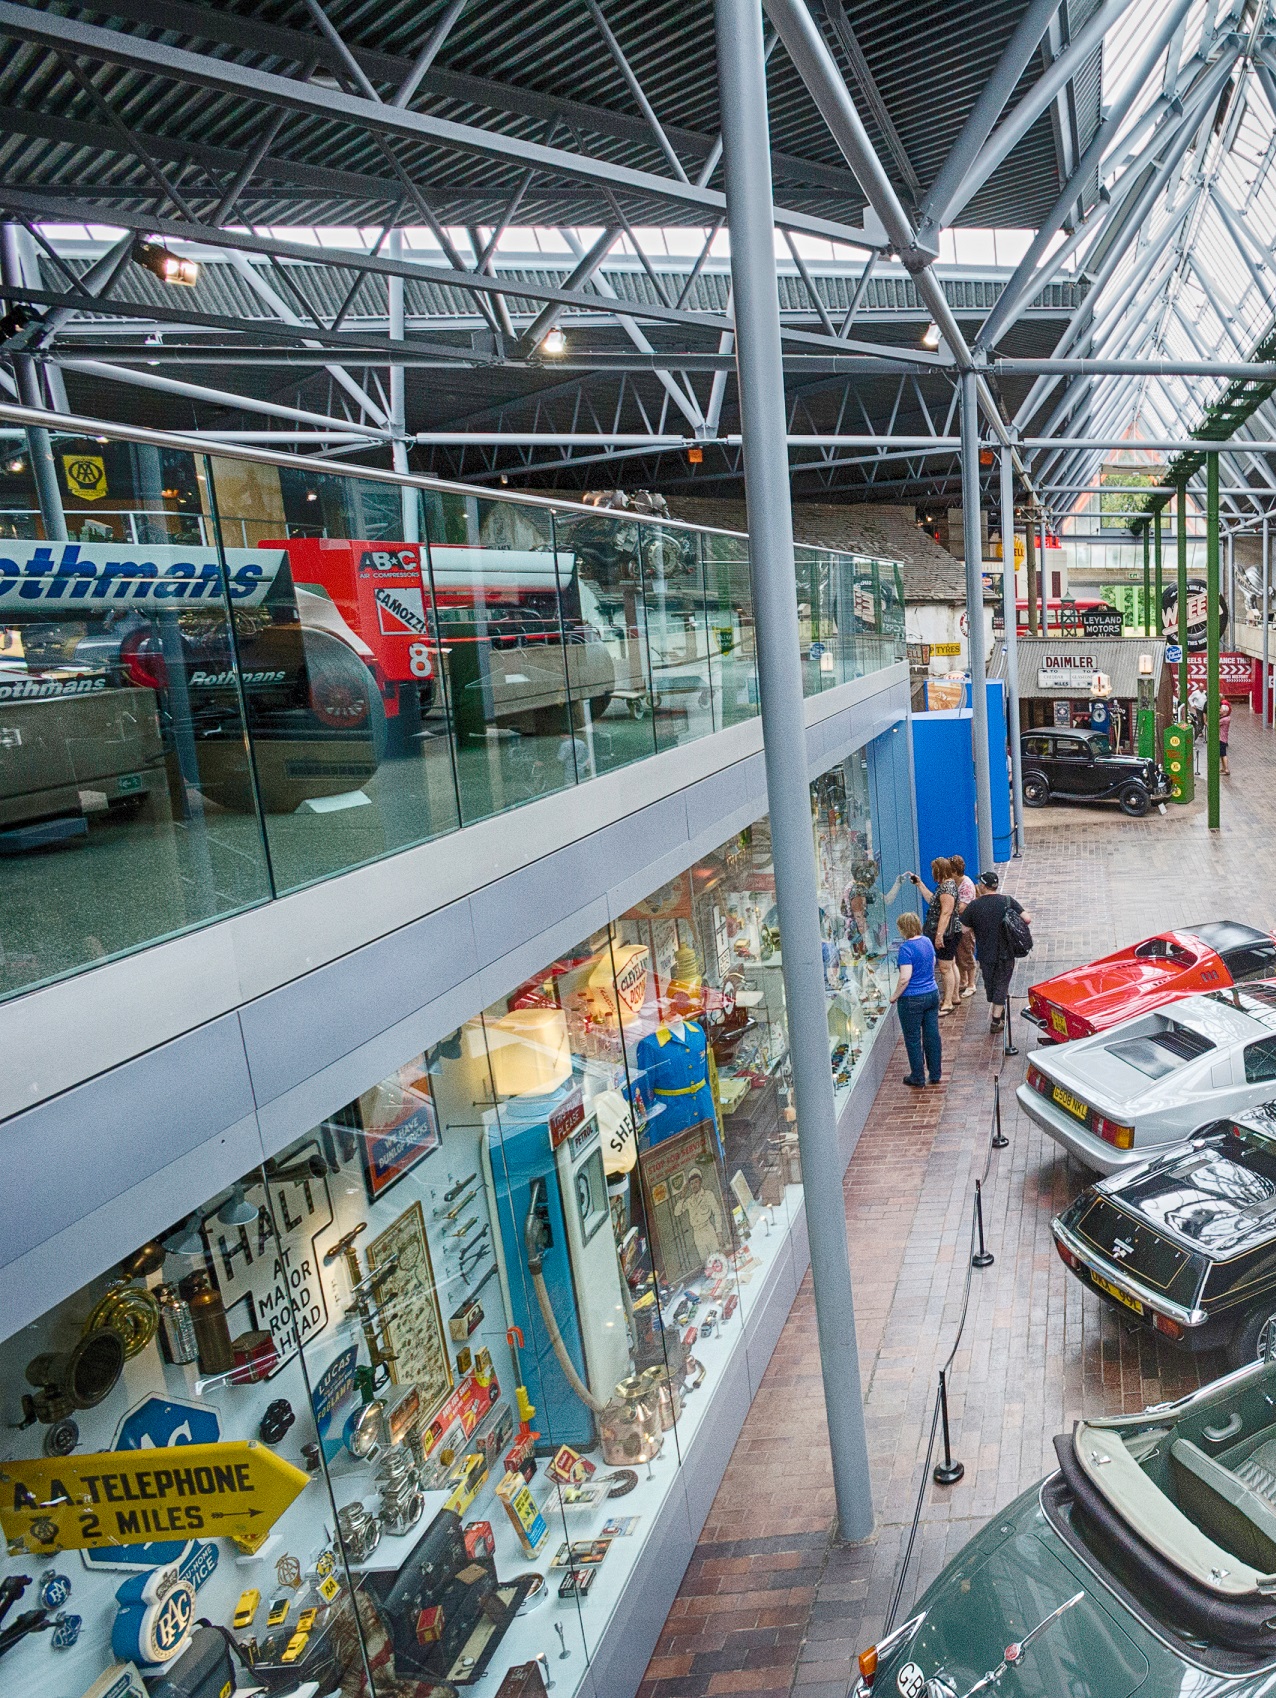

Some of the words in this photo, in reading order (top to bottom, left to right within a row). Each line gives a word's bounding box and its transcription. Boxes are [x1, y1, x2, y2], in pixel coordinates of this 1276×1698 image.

[1013, 547, 1024, 557] ELL
[0, 545, 263, 599] othmans
[376, 588, 427, 634] CAMOZZI
[1084, 616, 1122, 625] LEYLAND
[1086, 625, 1120, 633] MOTORS
[409, 643, 432, 678] 8
[936, 646, 960, 654] TYRES
[1046, 656, 1093, 668] DAIMLER
[0, 677, 105, 698] othmans
[1054, 1087, 1072, 1107] G508
[1071, 1098, 1088, 1119] NKL
[398, 1117, 418, 1136] HAVE
[558, 1109, 581, 1140] PLEASE
[574, 1123, 595, 1149] PETROL
[218, 1180, 315, 1282] HALT
[273, 1247, 291, 1280] AT
[258, 1260, 312, 1318] MAOR
[269, 1287, 311, 1337] ROAD
[319, 1352, 352, 1396] LUCAS
[79, 1513, 103, 1539] 2
[115, 1505, 206, 1536] MILES
[50, 1579, 67, 1604] RAC
[325, 1580, 336, 1594] AA
[158, 1592, 191, 1648] RAC
